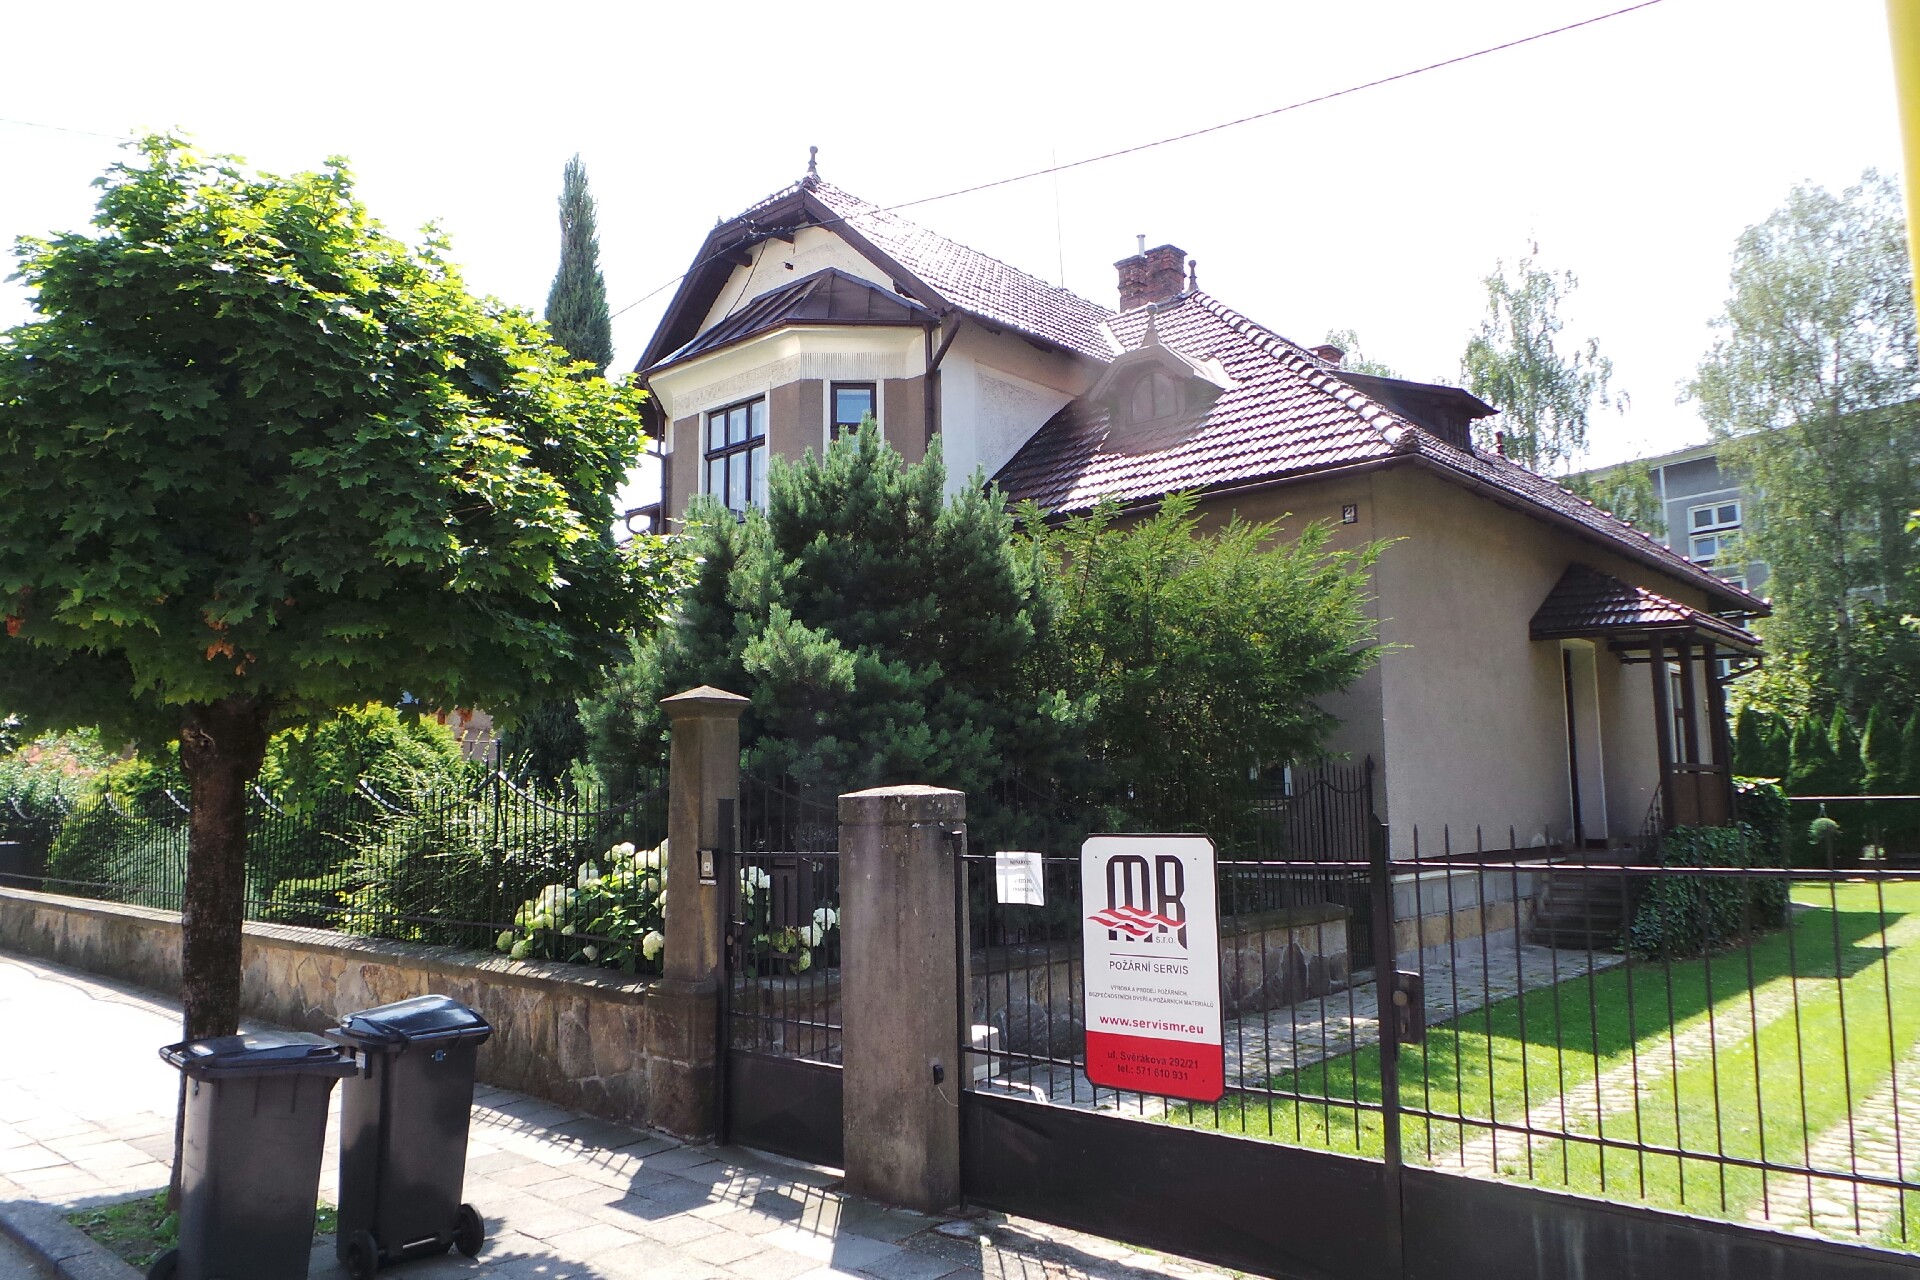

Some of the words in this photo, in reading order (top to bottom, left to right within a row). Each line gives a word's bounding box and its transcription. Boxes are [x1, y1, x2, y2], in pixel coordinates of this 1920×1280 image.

[1344, 506, 1355, 517] 21
[1155, 936, 1176, 944] s.r.o.
[1109, 960, 1150, 972] POŽÁRNÍ
[1153, 963, 1189, 975] SERVIS
[1100, 1015, 1204, 1034] www.servismr.eu
[1107, 1050, 1118, 1059] ul.
[1169, 1057, 1198, 1069] 292/21
[1117, 1063, 1134, 1074] tel.:
[1136, 1066, 1151, 1076] 571
[1154, 1068, 1170, 1078] 610
[1172, 1070, 1188, 1081] 931
